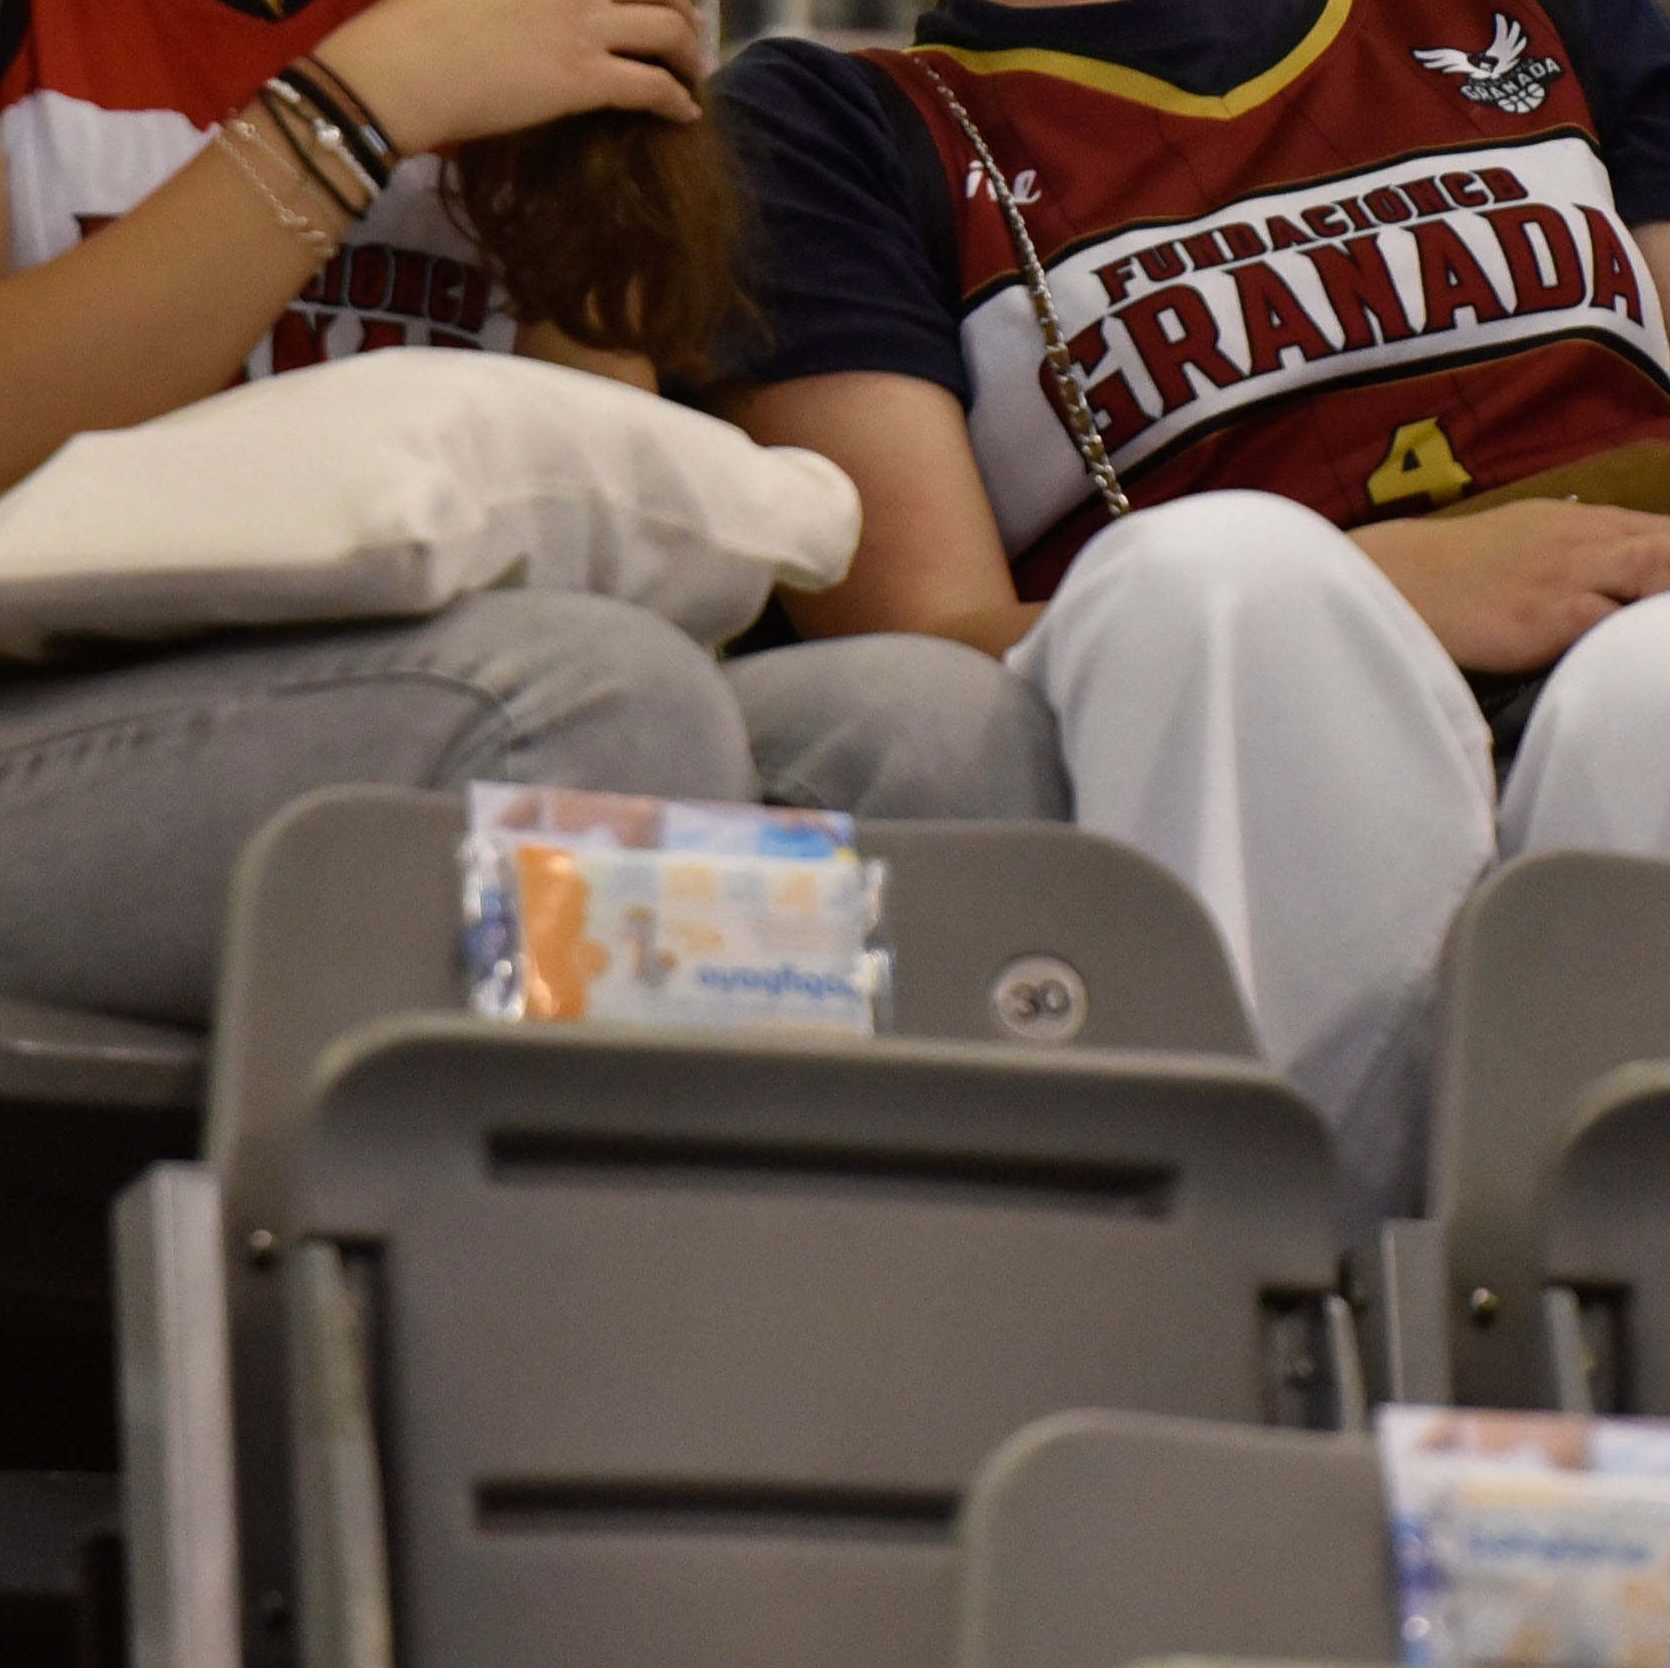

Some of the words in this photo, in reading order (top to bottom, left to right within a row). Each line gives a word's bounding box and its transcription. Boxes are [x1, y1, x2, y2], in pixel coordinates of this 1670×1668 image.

[1460, 57, 1562, 100] GRANADA
[1038, 201, 1645, 473] GRANADA
[1365, 415, 1474, 506] 4
